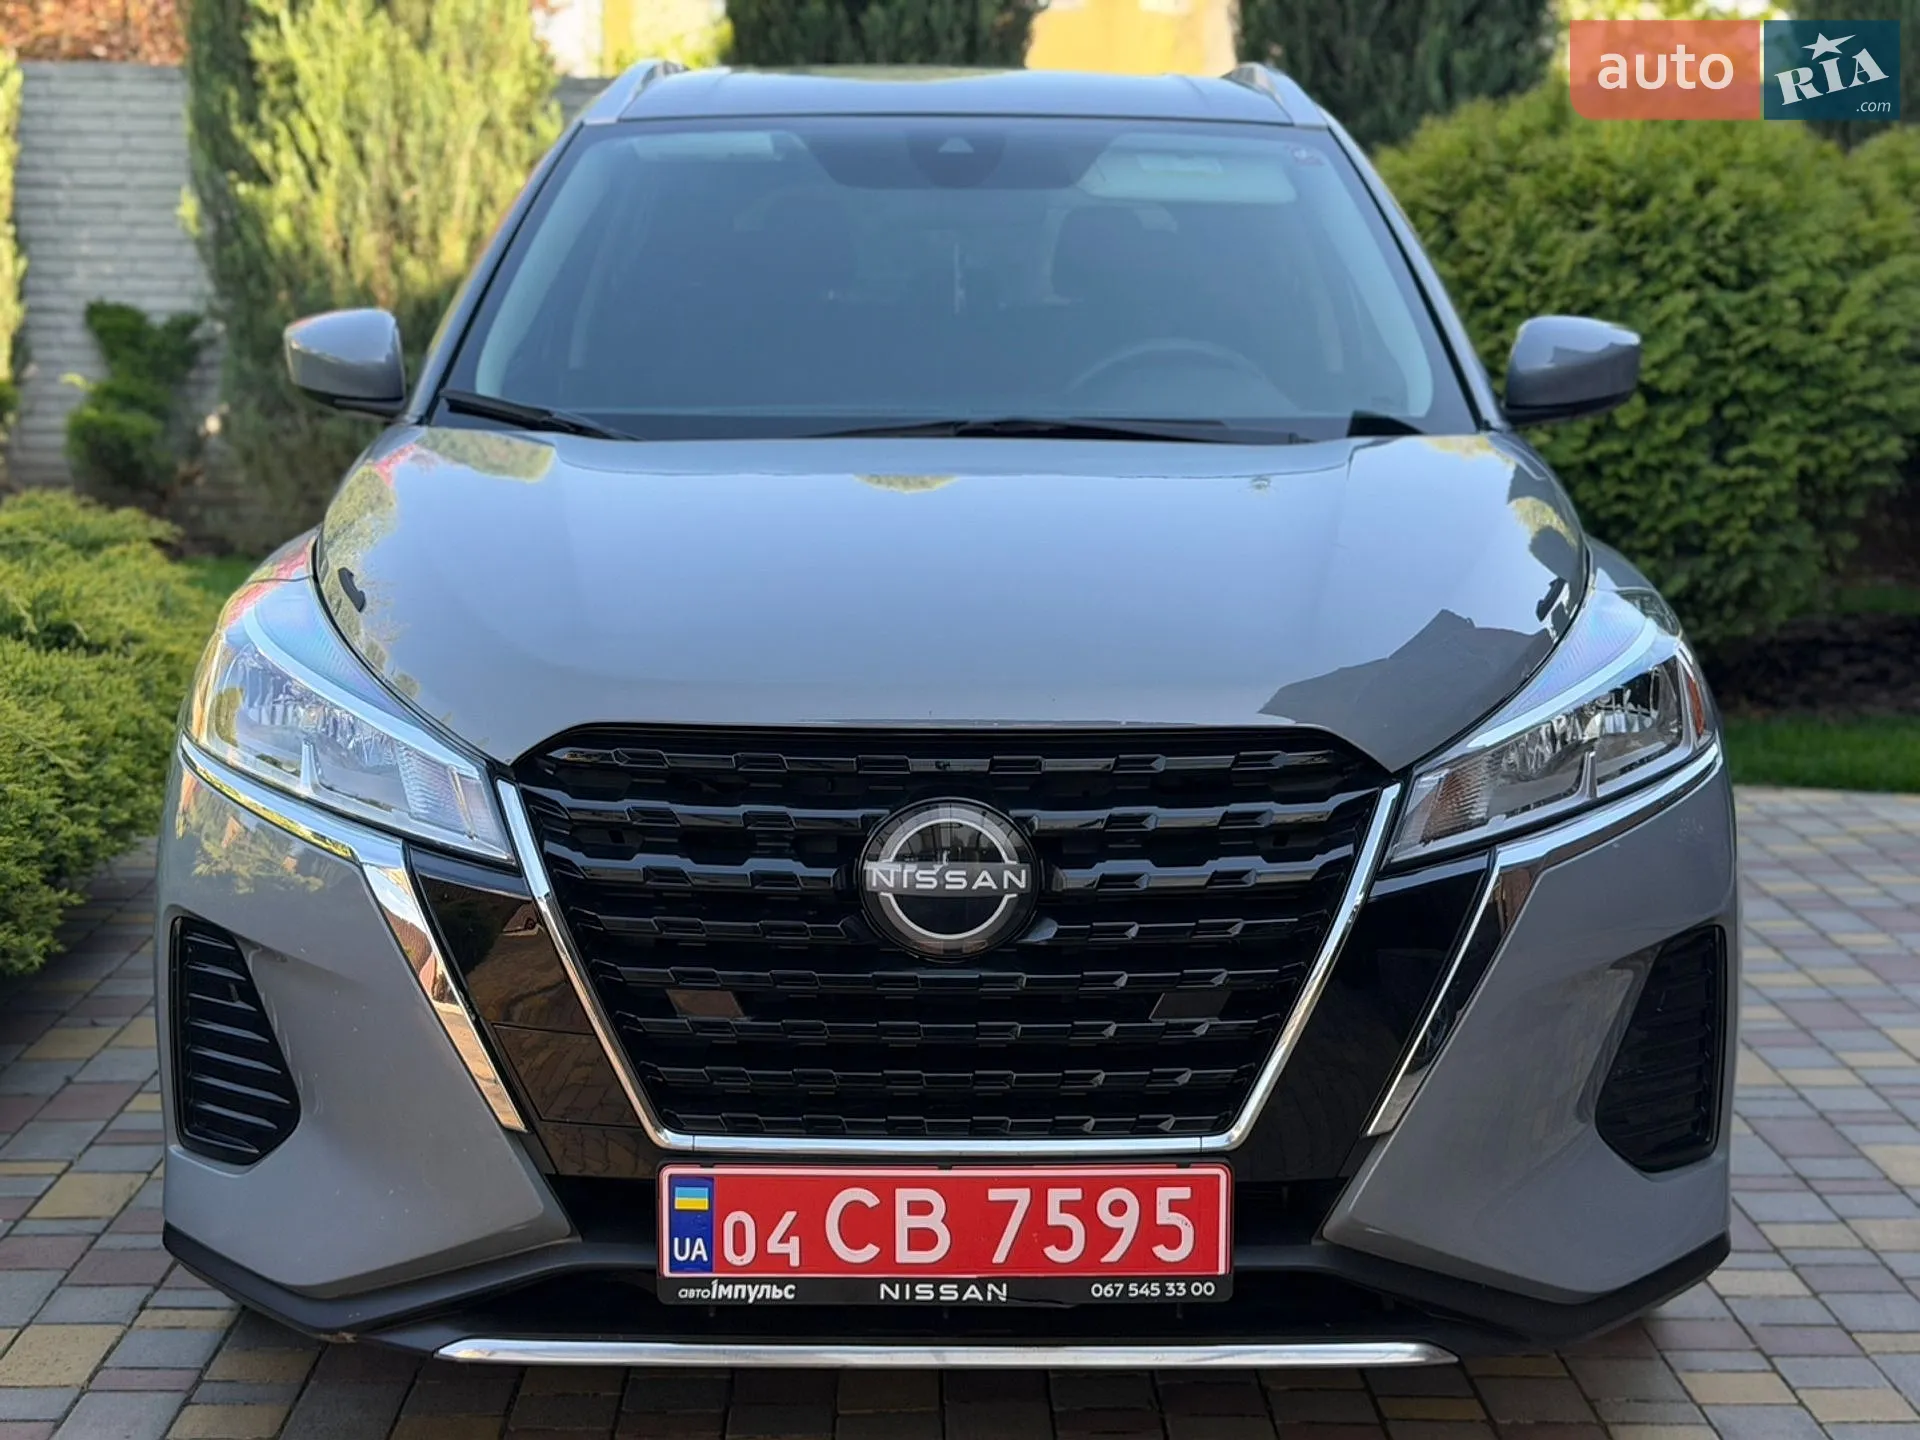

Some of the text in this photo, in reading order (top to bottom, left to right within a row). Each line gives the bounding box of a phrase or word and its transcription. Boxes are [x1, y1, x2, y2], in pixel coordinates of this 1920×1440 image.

[871, 868, 1027, 890] NISSAN
[722, 1186, 1196, 1267] 04 CB 7595
[673, 1237, 708, 1263] UA
[879, 1283, 1008, 1303] NISSAN
[1090, 1282, 1215, 1298] 067 545 33 00
